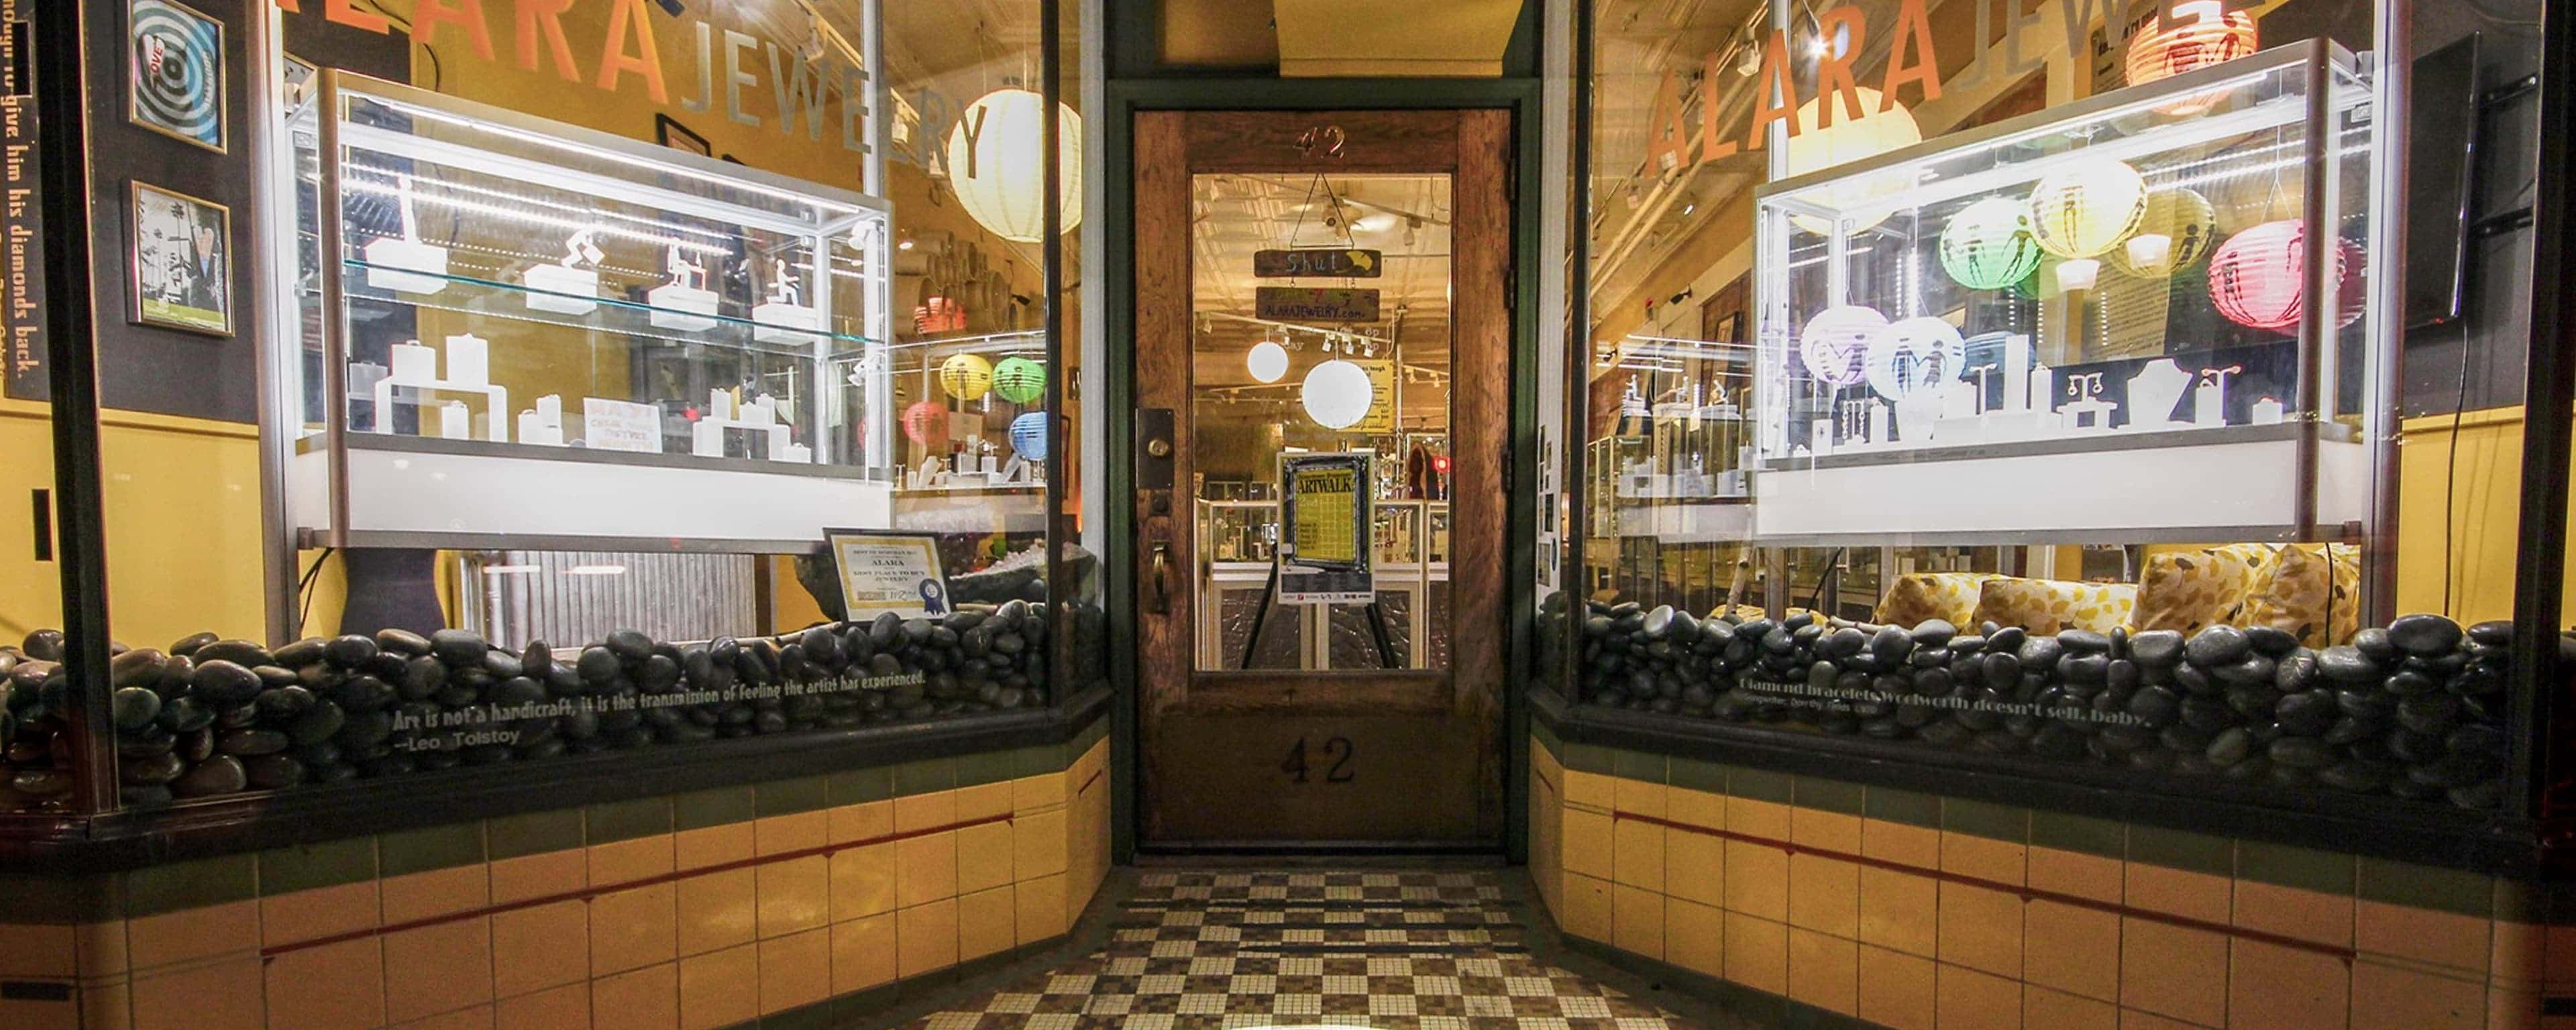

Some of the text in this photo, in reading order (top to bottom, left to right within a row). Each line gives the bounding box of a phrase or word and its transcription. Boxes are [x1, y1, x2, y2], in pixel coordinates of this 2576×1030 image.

[274, 0, 669, 105] ARA
[681, 21, 987, 179] JEWELRY
[1642, 0, 1943, 180] ALARA
[1, 96, 22, 137] give
[1292, 125, 1346, 160] 42
[7, 146, 29, 181] him
[9, 189, 30, 217] his
[10, 225, 36, 319] diamonds
[1286, 252, 1336, 272] Shut
[15, 327, 39, 379] back.
[1295, 477, 1352, 494] ARTWALK
[871, 559, 904, 567] ALARA
[392, 669, 926, 731] Art is not a handicraft, it is the transmission of feeling the artist has experienced.
[1739, 677, 1804, 695] Diamond
[1880, 689, 1969, 710] Woolworth
[453, 729, 521, 746] Tolstoy
[1281, 736, 1356, 783] 42
